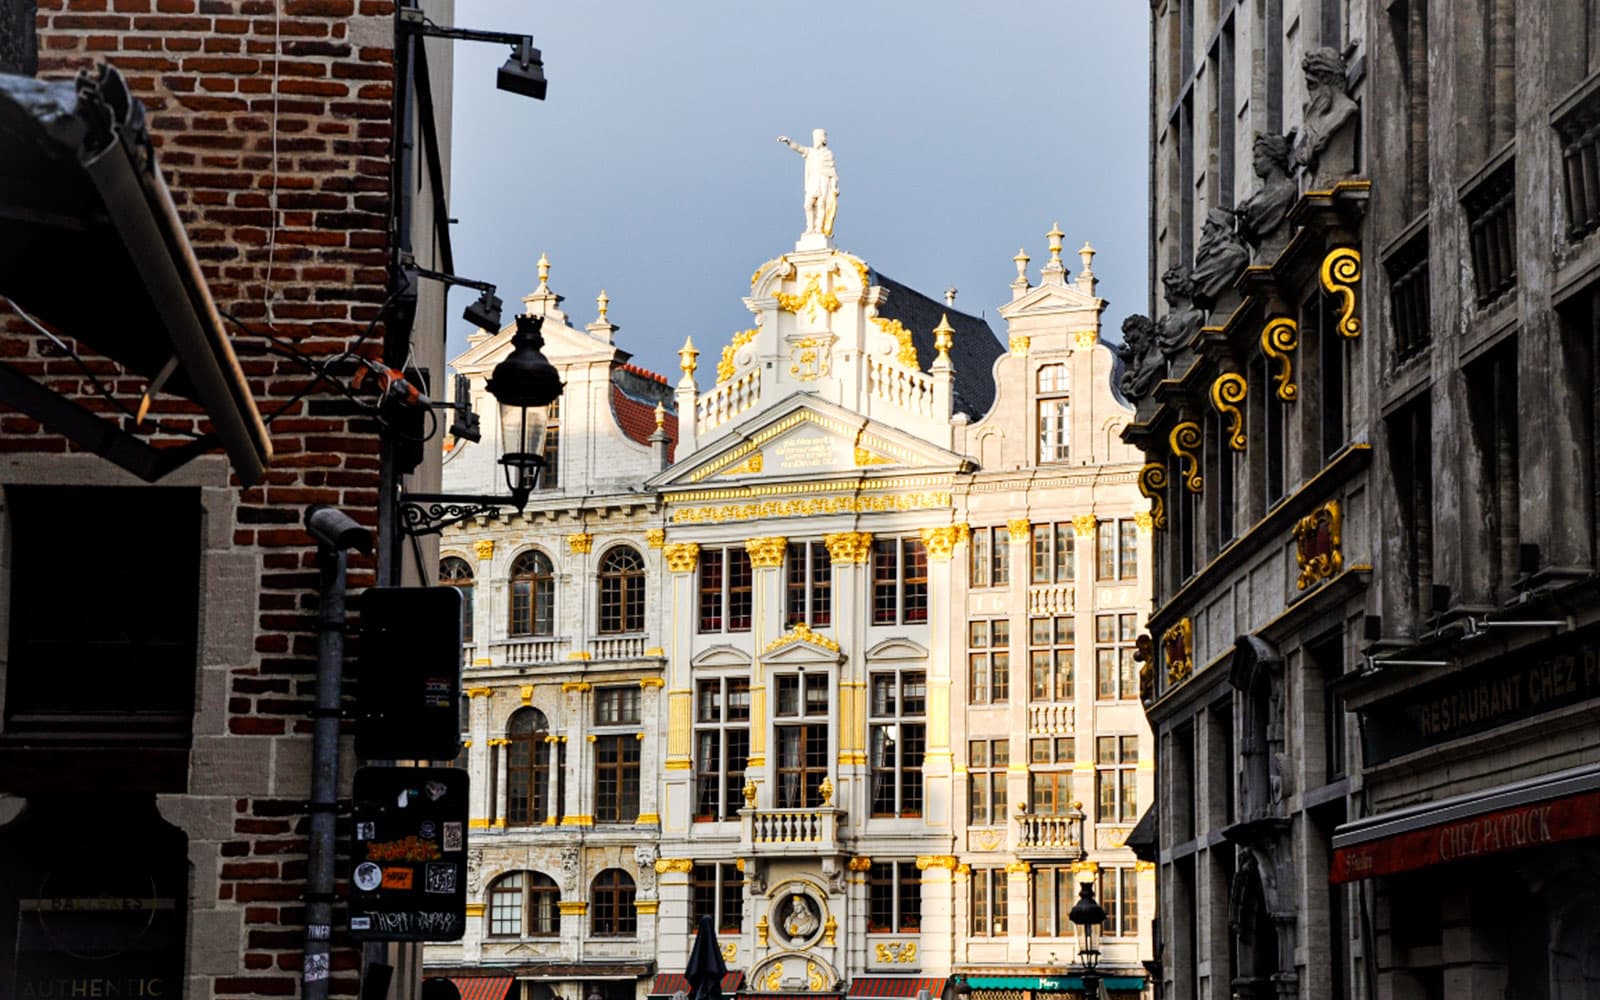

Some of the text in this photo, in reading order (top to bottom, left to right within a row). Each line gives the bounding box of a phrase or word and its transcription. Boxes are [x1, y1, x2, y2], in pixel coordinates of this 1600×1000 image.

[1422, 673, 1521, 736] RESTAURANT
[1528, 656, 1577, 705] CHEZ
[1439, 806, 1553, 861] CHEZ PATRICK
[24, 977, 164, 998] AUTHENTIC
